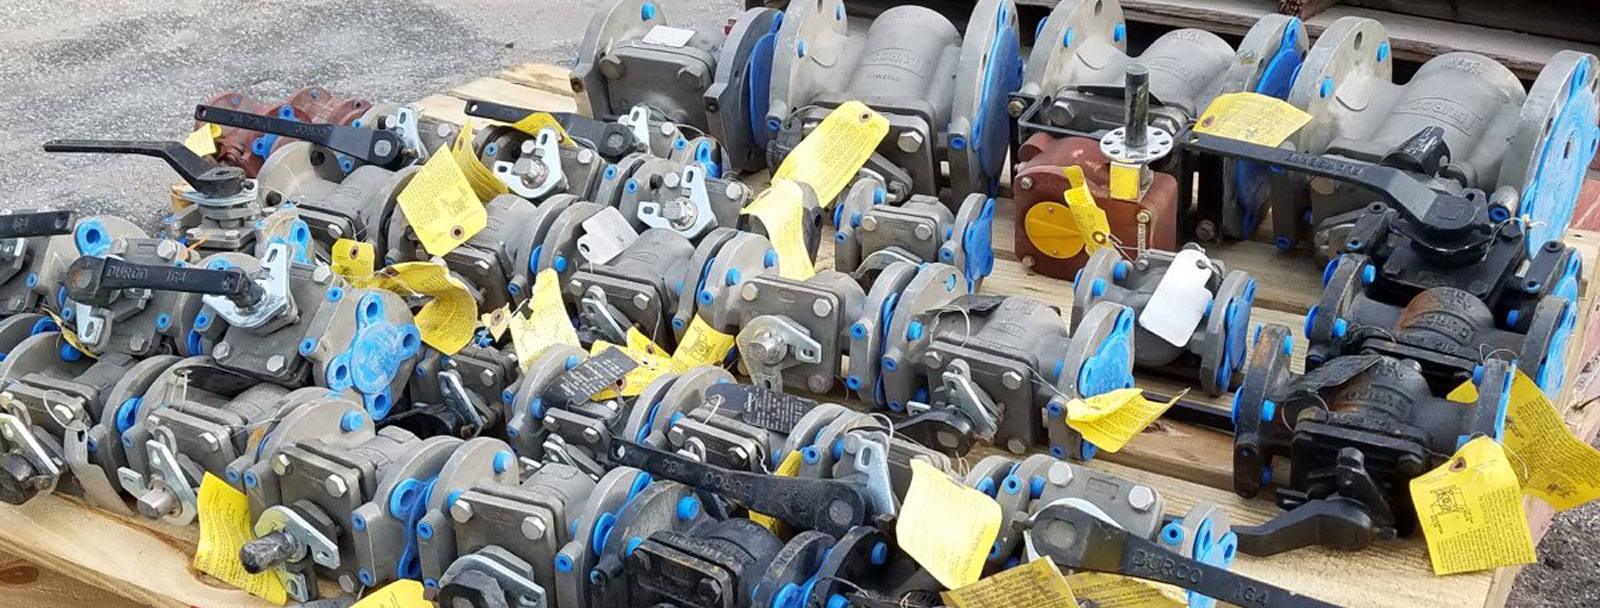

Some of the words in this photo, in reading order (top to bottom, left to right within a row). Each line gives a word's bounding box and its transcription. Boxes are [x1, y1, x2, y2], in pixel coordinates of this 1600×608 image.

[703, 470, 755, 497] DURCO
[1131, 549, 1203, 584] DURCO
[1235, 581, 1269, 606] 1G4
